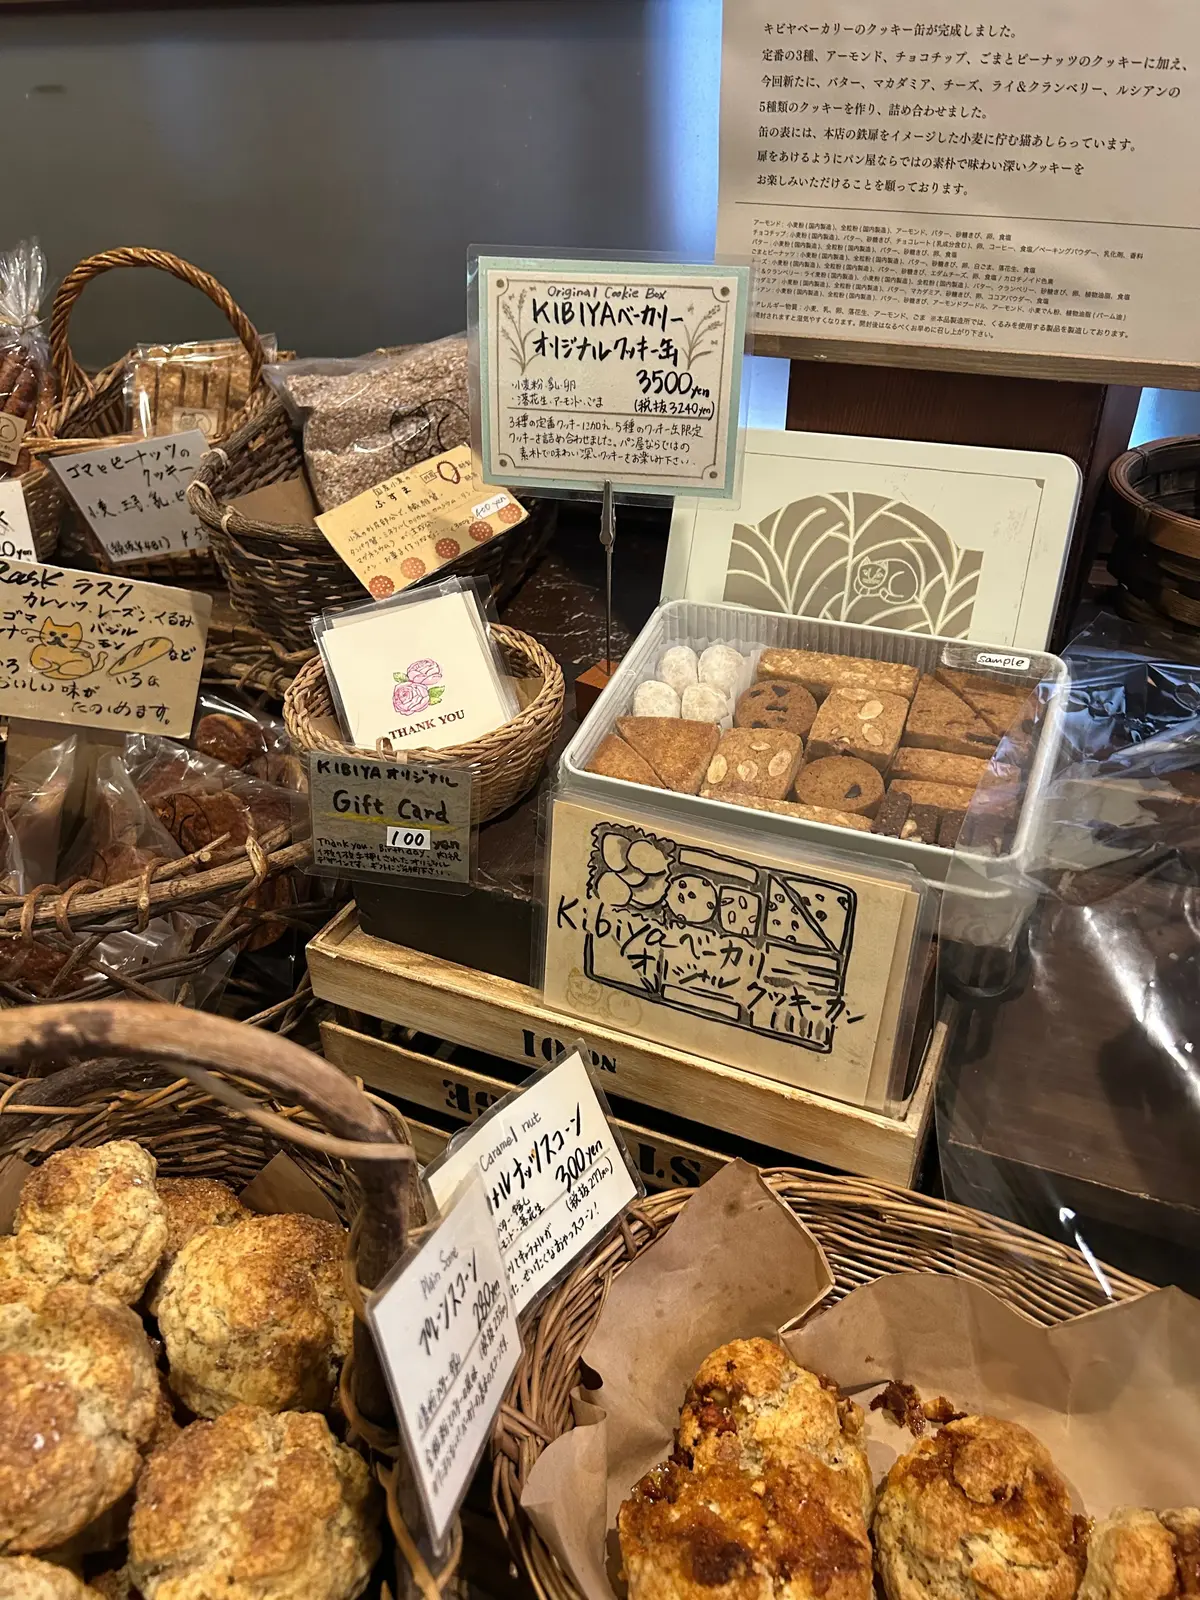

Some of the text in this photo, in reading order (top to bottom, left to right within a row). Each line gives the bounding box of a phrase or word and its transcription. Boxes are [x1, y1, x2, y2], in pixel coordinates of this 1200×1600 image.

[763, 21, 1017, 39] キビヤベーカリーのクッキー缶が完成しました。
[761, 47, 1190, 72] 定番の3種、アーモンド、チョコチップ、ごまとピーナッツのクッキーに加え、
[760, 74, 1181, 99] 今回新たに、バター、マカダミア、チーズ、ライ&クランベリー、ルシアンの
[758, 100, 989, 120] 5種類のクッキーを作り、詰め合わせました。
[757, 125, 1136, 153] 缶の表には、本店の鉄扉をイメージした小麦に佇む猫あしらっています。
[756, 150, 1085, 175] 扉をあけるようにパン屋ならではの素朴で味わい深いクッキーを
[756, 174, 970, 196] お楽しみいただけることを願っております。
[547, 285, 667, 300] Original Cookie Box
[531, 298, 683, 332] KIBIYAベーカリー
[531, 331, 679, 367] オリジナルクッキー缶
[635, 369, 710, 399] 3500yen
[634, 398, 715, 421] (税抜3240yen)
[508, 432, 690, 453] クッキーを詰め合わせました。パン屋ならではの
[374, 486, 412, 509] ふすま
[73, 578, 134, 604] ラスク
[90, 622, 139, 637] バジル
[168, 647, 197, 662] など
[388, 709, 466, 741] THANK YOU
[317, 759, 459, 788] KIBIYA オリジナル
[332, 789, 450, 824] Gift Card
[391, 830, 425, 846] 100
[746, 981, 867, 1024] クッキーカン
[479, 1112, 542, 1172] Caramel nut
[554, 1140, 604, 1193] 300yen
